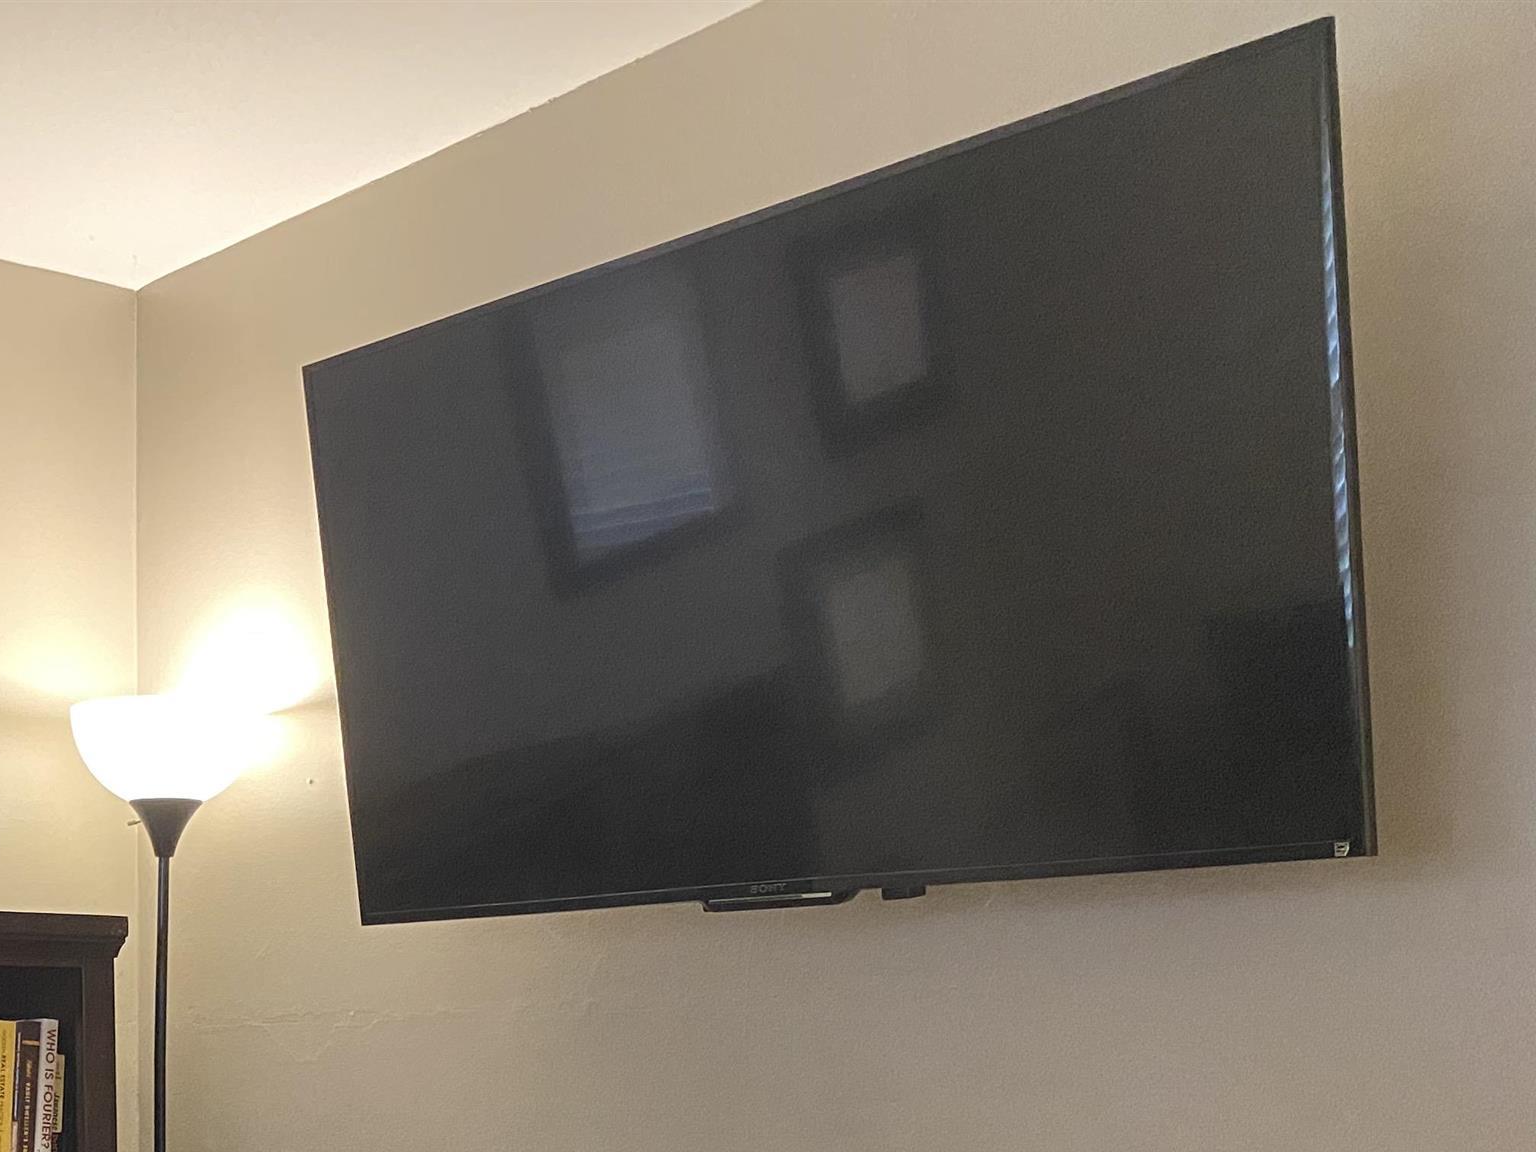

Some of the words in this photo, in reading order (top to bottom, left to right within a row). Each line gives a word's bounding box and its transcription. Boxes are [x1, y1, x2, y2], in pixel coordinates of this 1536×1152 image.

[750, 882, 787, 894] SONY
[44, 1029, 56, 1063] WHO
[44, 1068, 53, 1079] IS
[39, 1084, 53, 1148] FOURIER?
